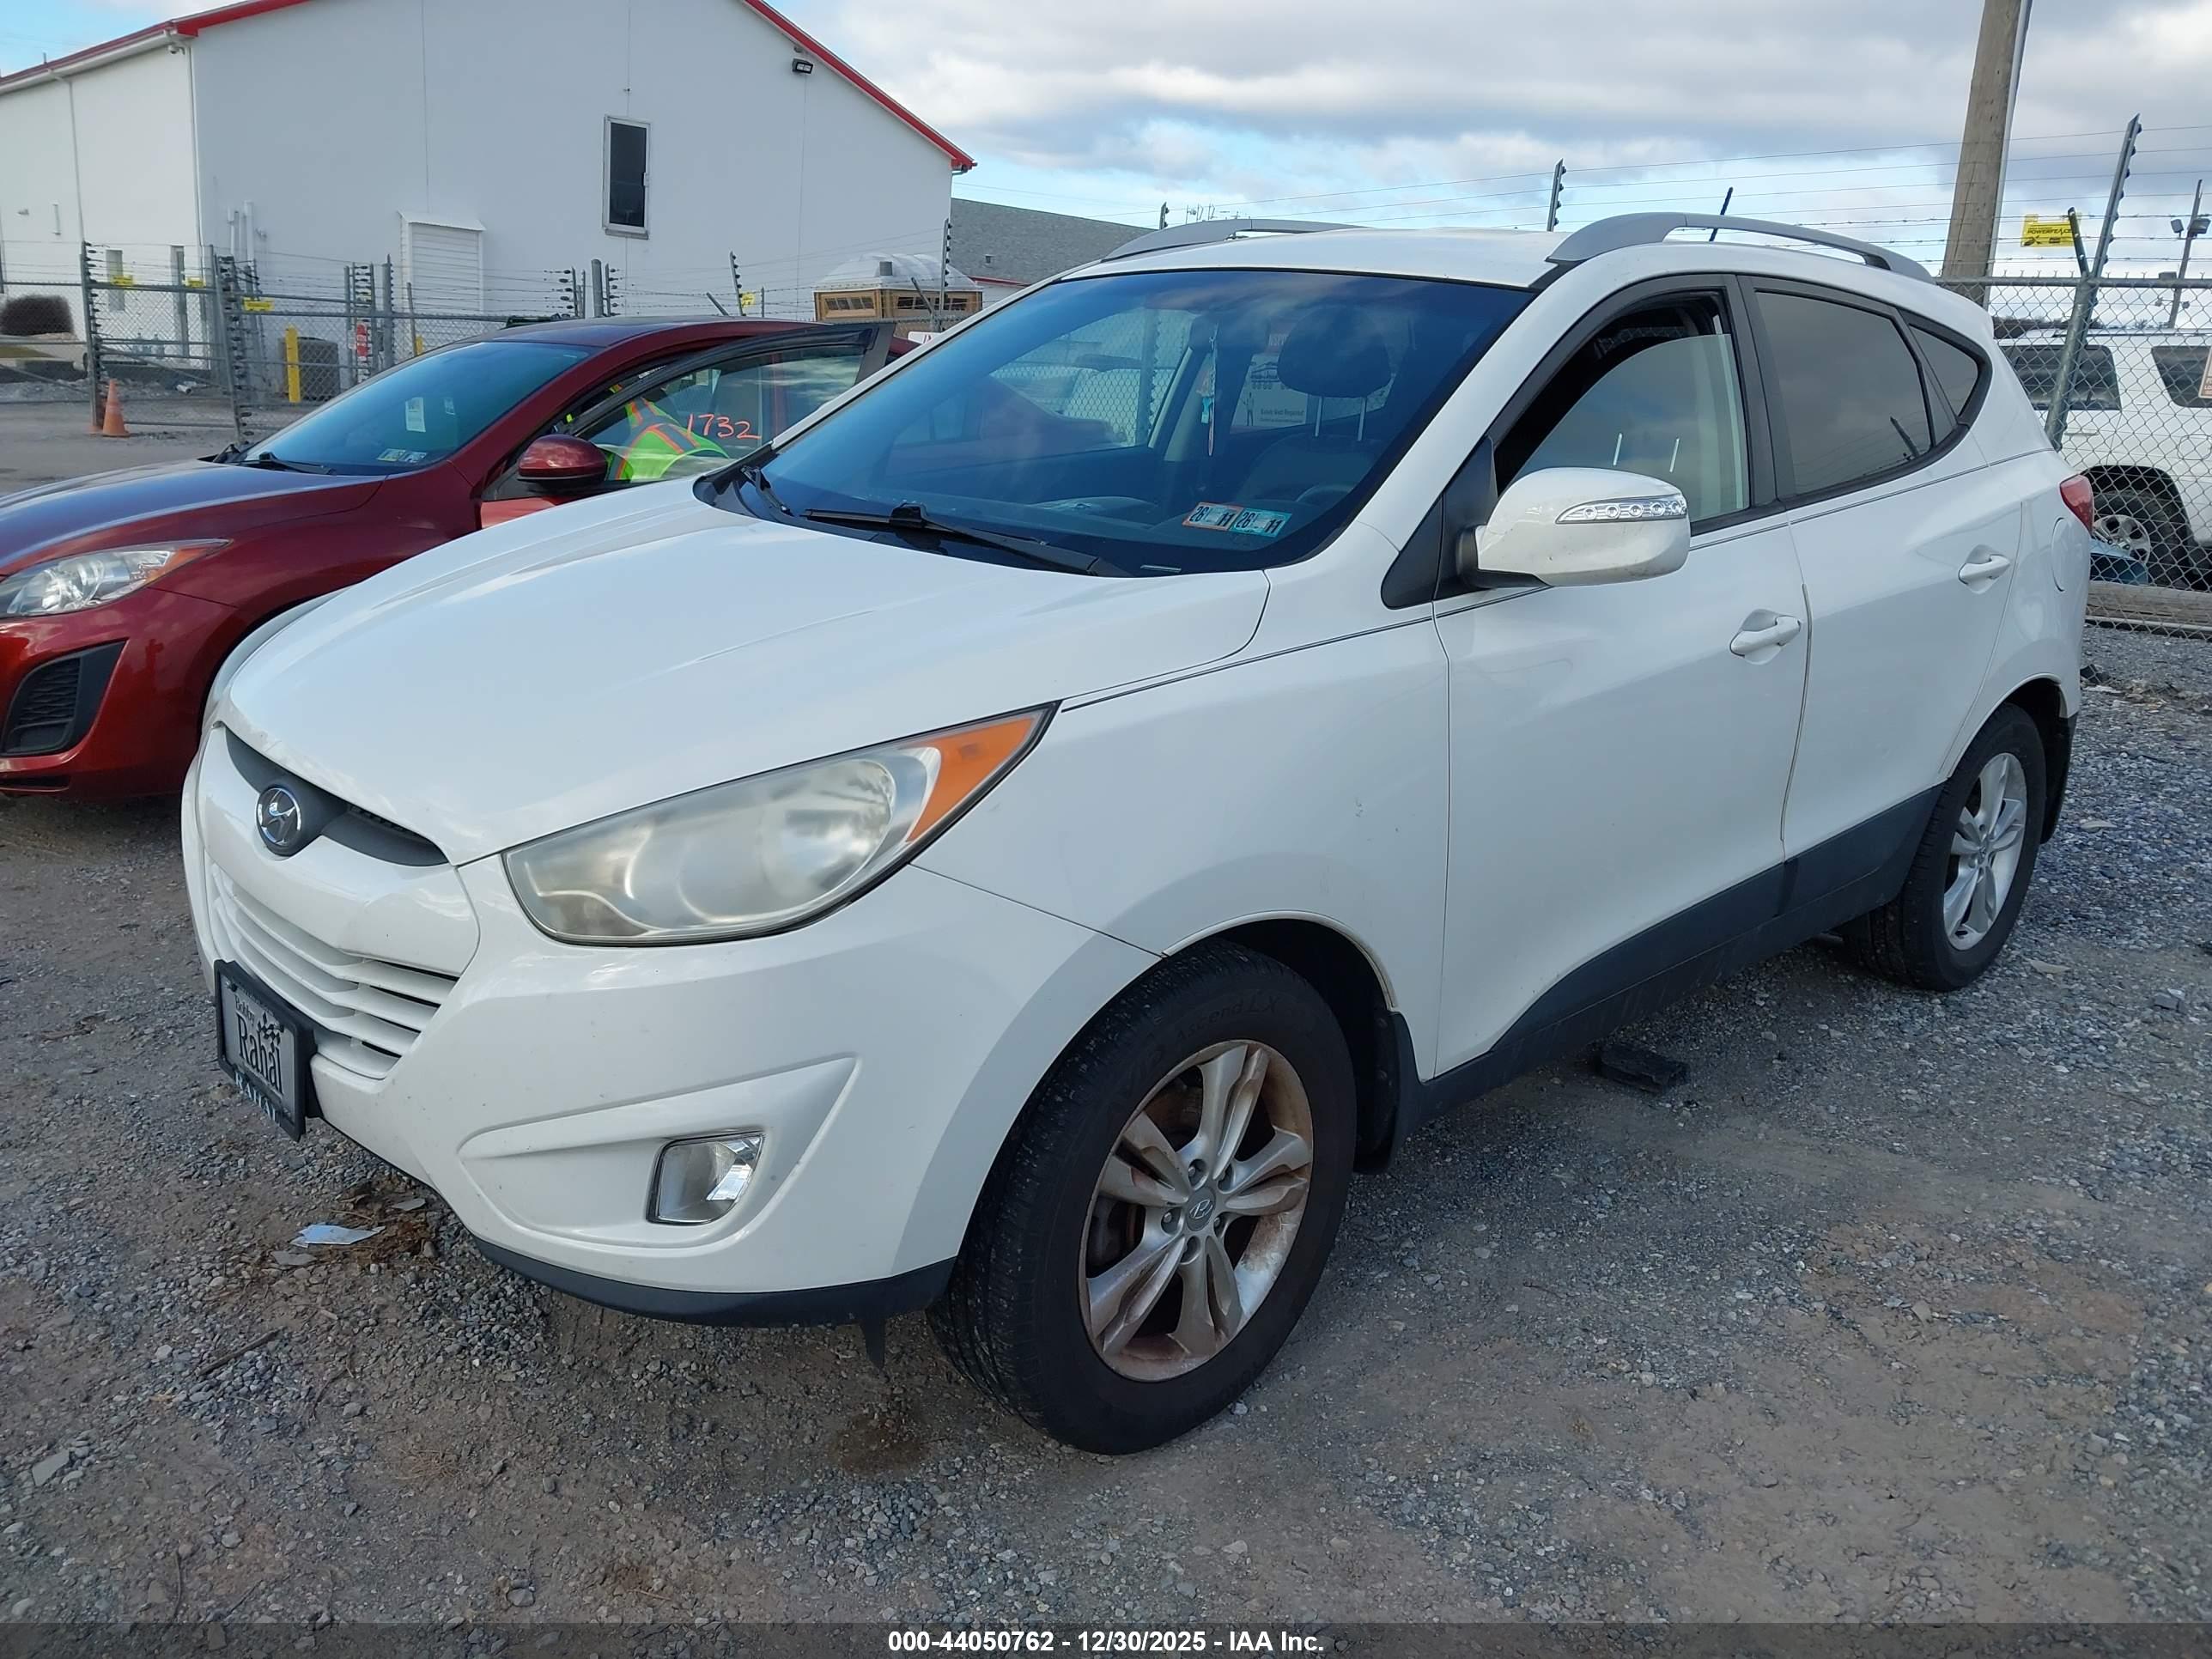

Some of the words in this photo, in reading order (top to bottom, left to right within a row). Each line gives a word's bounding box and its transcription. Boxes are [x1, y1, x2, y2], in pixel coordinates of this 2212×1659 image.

[686, 413, 763, 440] 1732
[1188, 506, 1209, 522] 26
[1236, 512, 1255, 528] 26
[237, 1013, 283, 1095] Rahal
